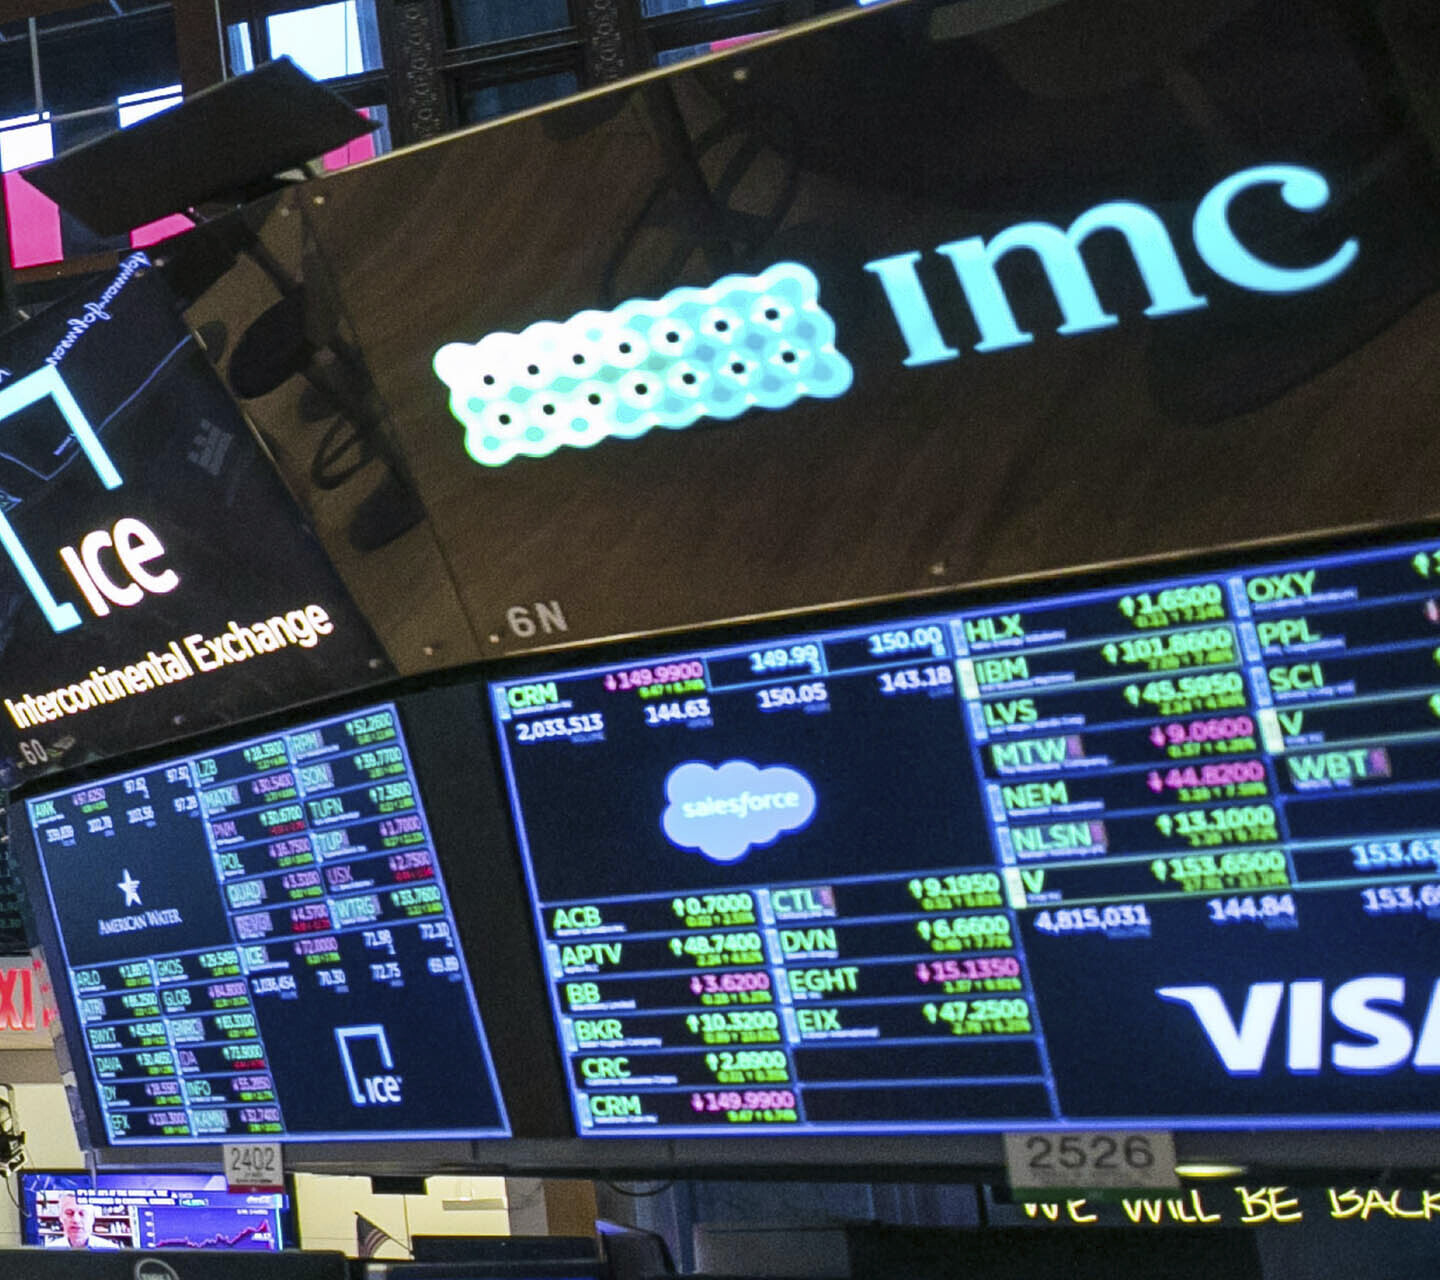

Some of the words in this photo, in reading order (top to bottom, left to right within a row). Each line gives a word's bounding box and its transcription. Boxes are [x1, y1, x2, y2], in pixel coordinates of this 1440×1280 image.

[865, 163, 1359, 368] imc
[1247, 571, 1316, 601] OXY
[508, 601, 568, 638] 6N
[966, 615, 1023, 642] HLX
[1258, 619, 1320, 646] PPL
[3, 640, 188, 730] Intercontinental
[183, 601, 333, 677] Exchange
[508, 684, 559, 707] CRM
[870, 627, 943, 655] 150.00
[975, 657, 1028, 683] IBM
[1269, 664, 1324, 691] SCI
[646, 700, 710, 724] 144.63
[758, 684, 827, 710] 150.05
[984, 699, 1037, 725] LVS
[992, 737, 1067, 767] MTW
[1290, 750, 1367, 781] WBT
[681, 789, 800, 820] salesforce
[1003, 783, 1068, 809] NEM
[1012, 824, 1092, 851] NLSN
[553, 907, 602, 929] ACB
[772, 892, 820, 916] CTL
[1034, 905, 1150, 934] 4,815,031
[1208, 894, 1295, 922] 144.84
[561, 944, 622, 967] APTV
[566, 983, 601, 1004] BB
[790, 968, 860, 992] EGHT
[1156, 976, 1440, 1074] VIS
[231, 1146, 276, 1172] 2402
[1026, 1136, 1155, 1169] 2526
[1235, 1187, 1302, 1222] BE
